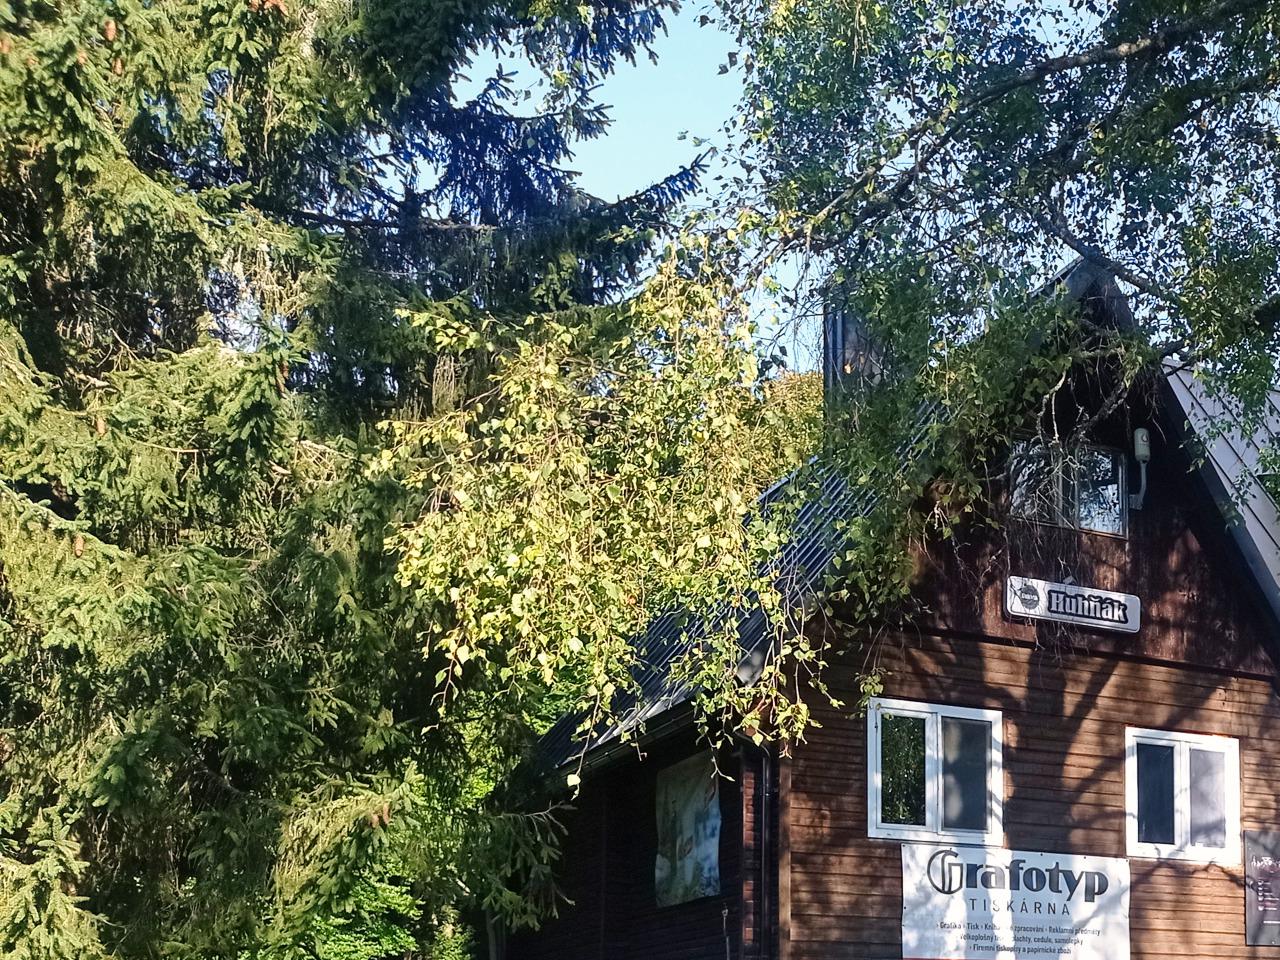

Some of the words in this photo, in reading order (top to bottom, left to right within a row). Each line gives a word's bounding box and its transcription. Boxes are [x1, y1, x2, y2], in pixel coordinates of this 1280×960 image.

[1048, 590, 1128, 624] Huhňák
[927, 849, 1109, 903] Grafotyp
[970, 898, 1071, 916] TISKÁRNA
